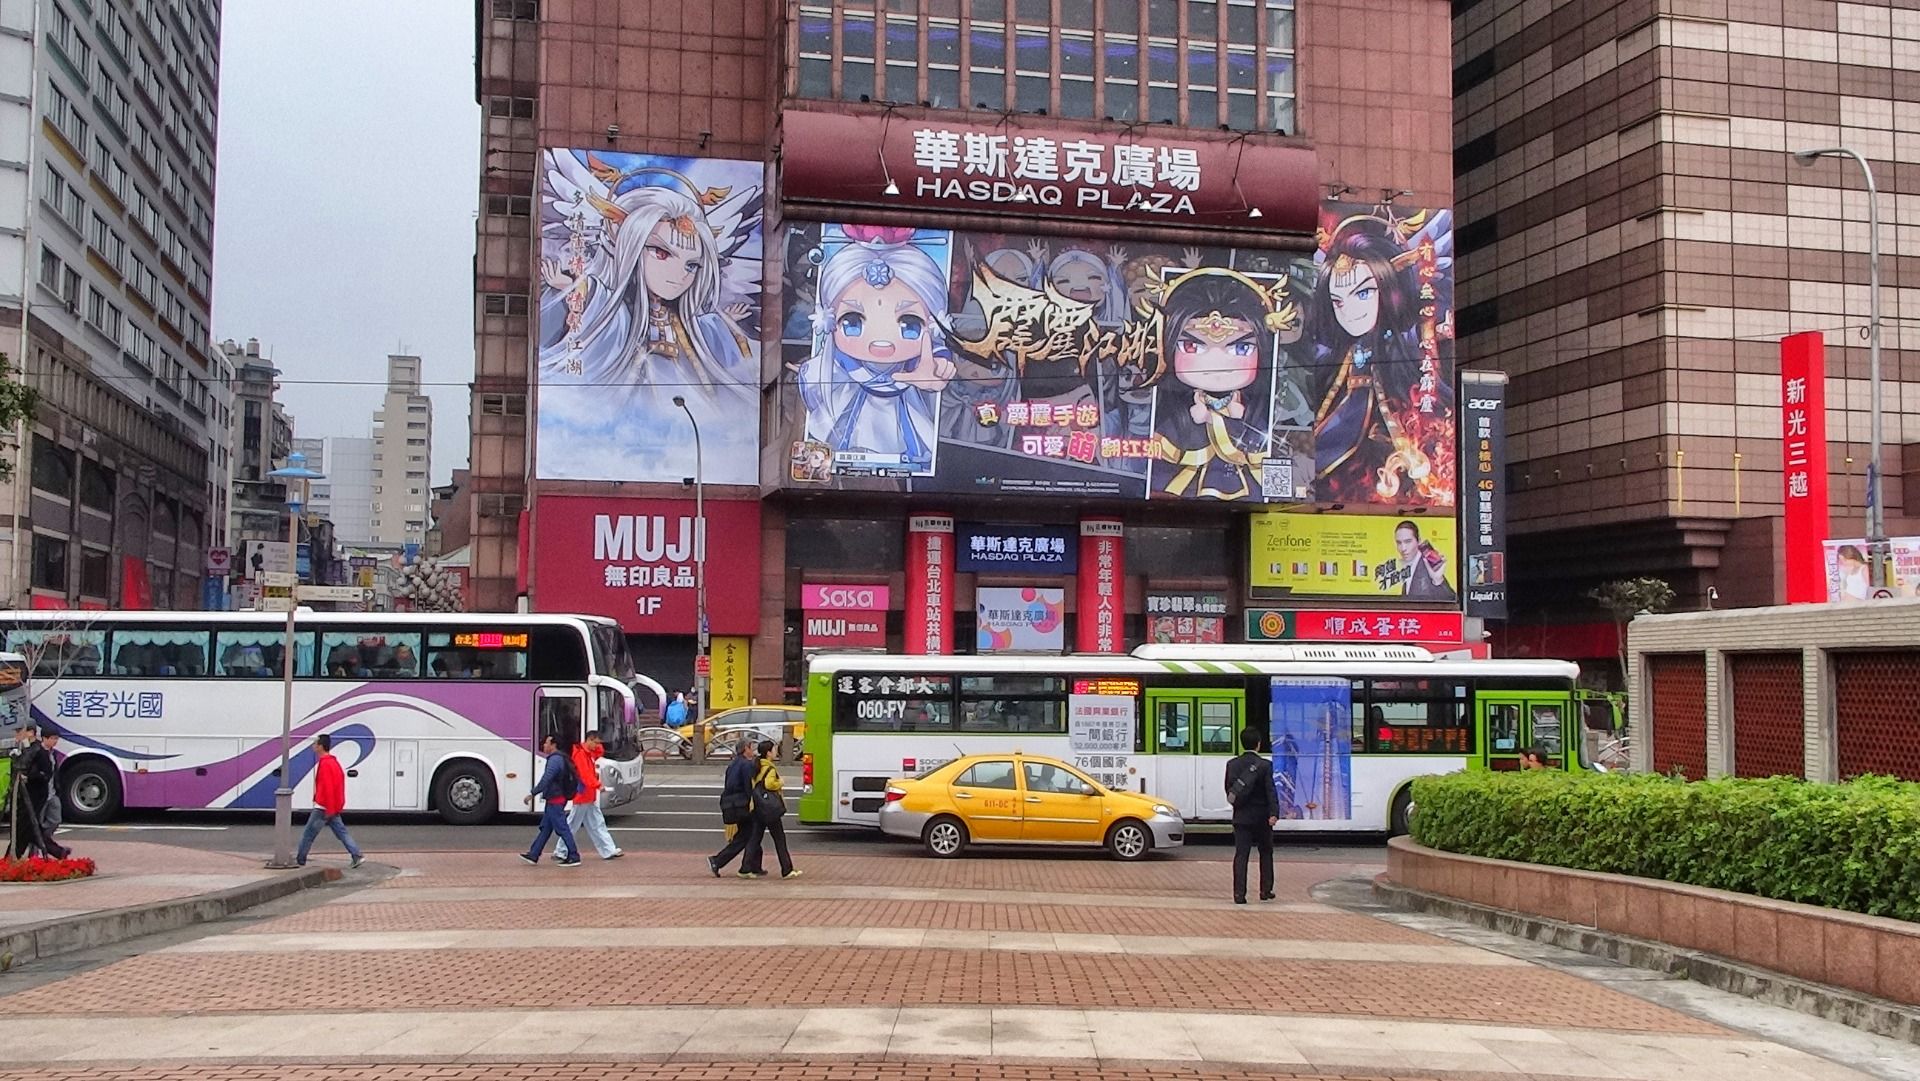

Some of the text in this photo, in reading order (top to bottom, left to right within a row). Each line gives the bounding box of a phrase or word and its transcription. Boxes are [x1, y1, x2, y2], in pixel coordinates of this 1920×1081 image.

[913, 128, 1202, 193] 華斯達克廣場
[916, 176, 1196, 216] HASDAQ PLAZA
[1468, 397, 1501, 411] acer
[1006, 402, 1100, 428] 霹靂手遊
[1786, 377, 1808, 498] 新光三越
[594, 514, 706, 563] MUJI
[970, 535, 1065, 554] 華斯達克廣場
[971, 552, 1063, 562] HASDAQ PLAZA
[604, 564, 695, 588] 無印良品
[636, 596, 662, 616] 1F
[808, 618, 846, 637] MUJI
[1324, 616, 1422, 637] 順成蛋糕
[856, 700, 906, 721] 060-FY
[1074, 755, 1128, 768] 76個國家
